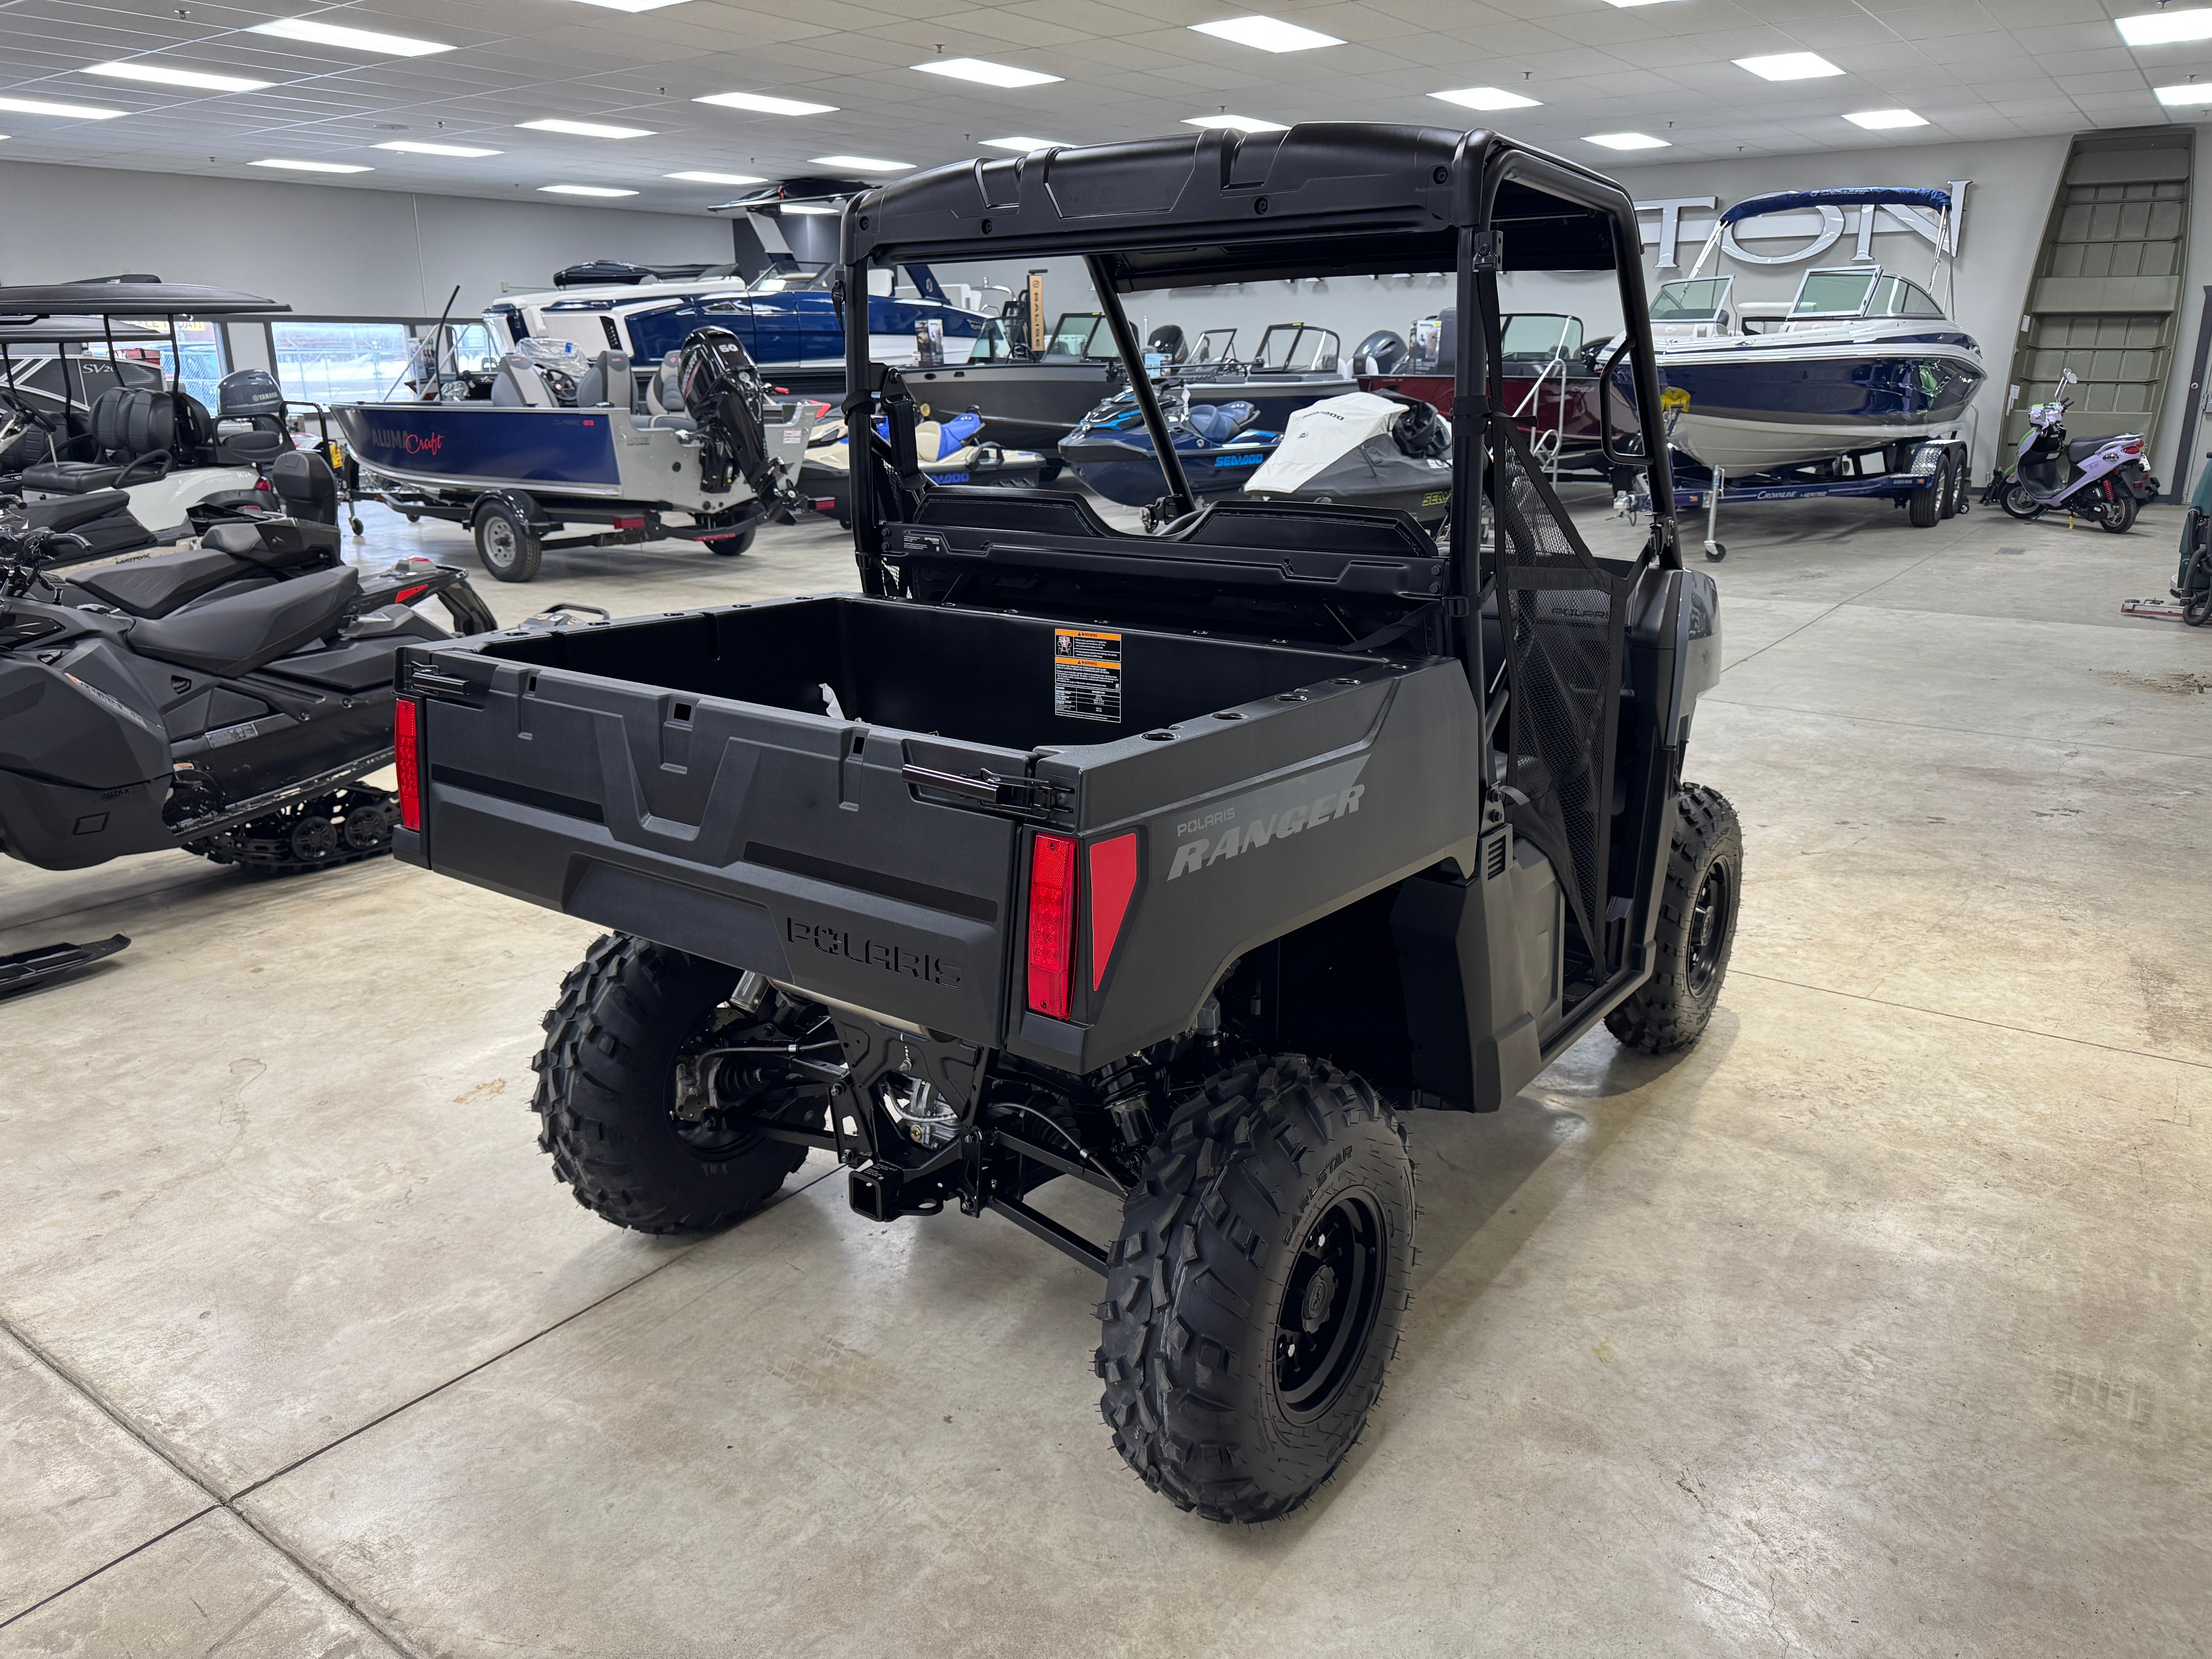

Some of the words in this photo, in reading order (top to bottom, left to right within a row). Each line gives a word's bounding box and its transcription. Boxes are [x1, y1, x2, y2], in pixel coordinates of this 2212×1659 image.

[718, 343, 738, 353] 60
[371, 428, 412, 449] ALUMA
[405, 432, 445, 455] Craft
[1166, 784, 1365, 881] RANGER
[1177, 807, 1235, 836] POLARIS
[787, 917, 962, 990] POLARIS
[1282, 1145, 1353, 1247] CARLSTAR
